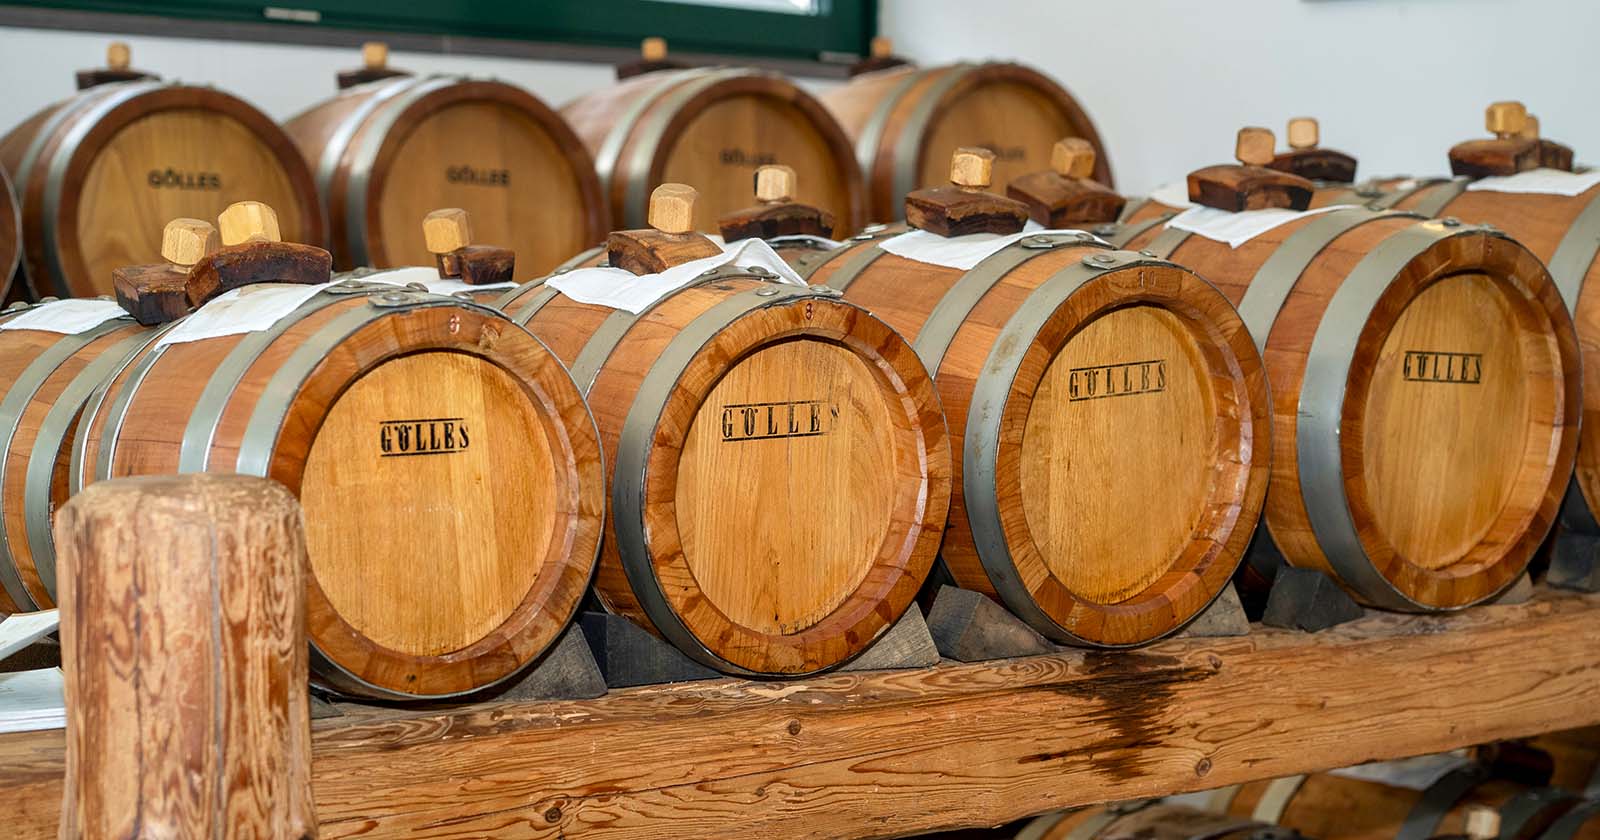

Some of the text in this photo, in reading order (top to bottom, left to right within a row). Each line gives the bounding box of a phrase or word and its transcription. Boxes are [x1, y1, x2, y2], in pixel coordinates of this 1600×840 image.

[1068, 361, 1166, 398] GÖLLES
[1403, 353, 1482, 381] GÖLLES
[380, 422, 469, 453] GÖLLES
